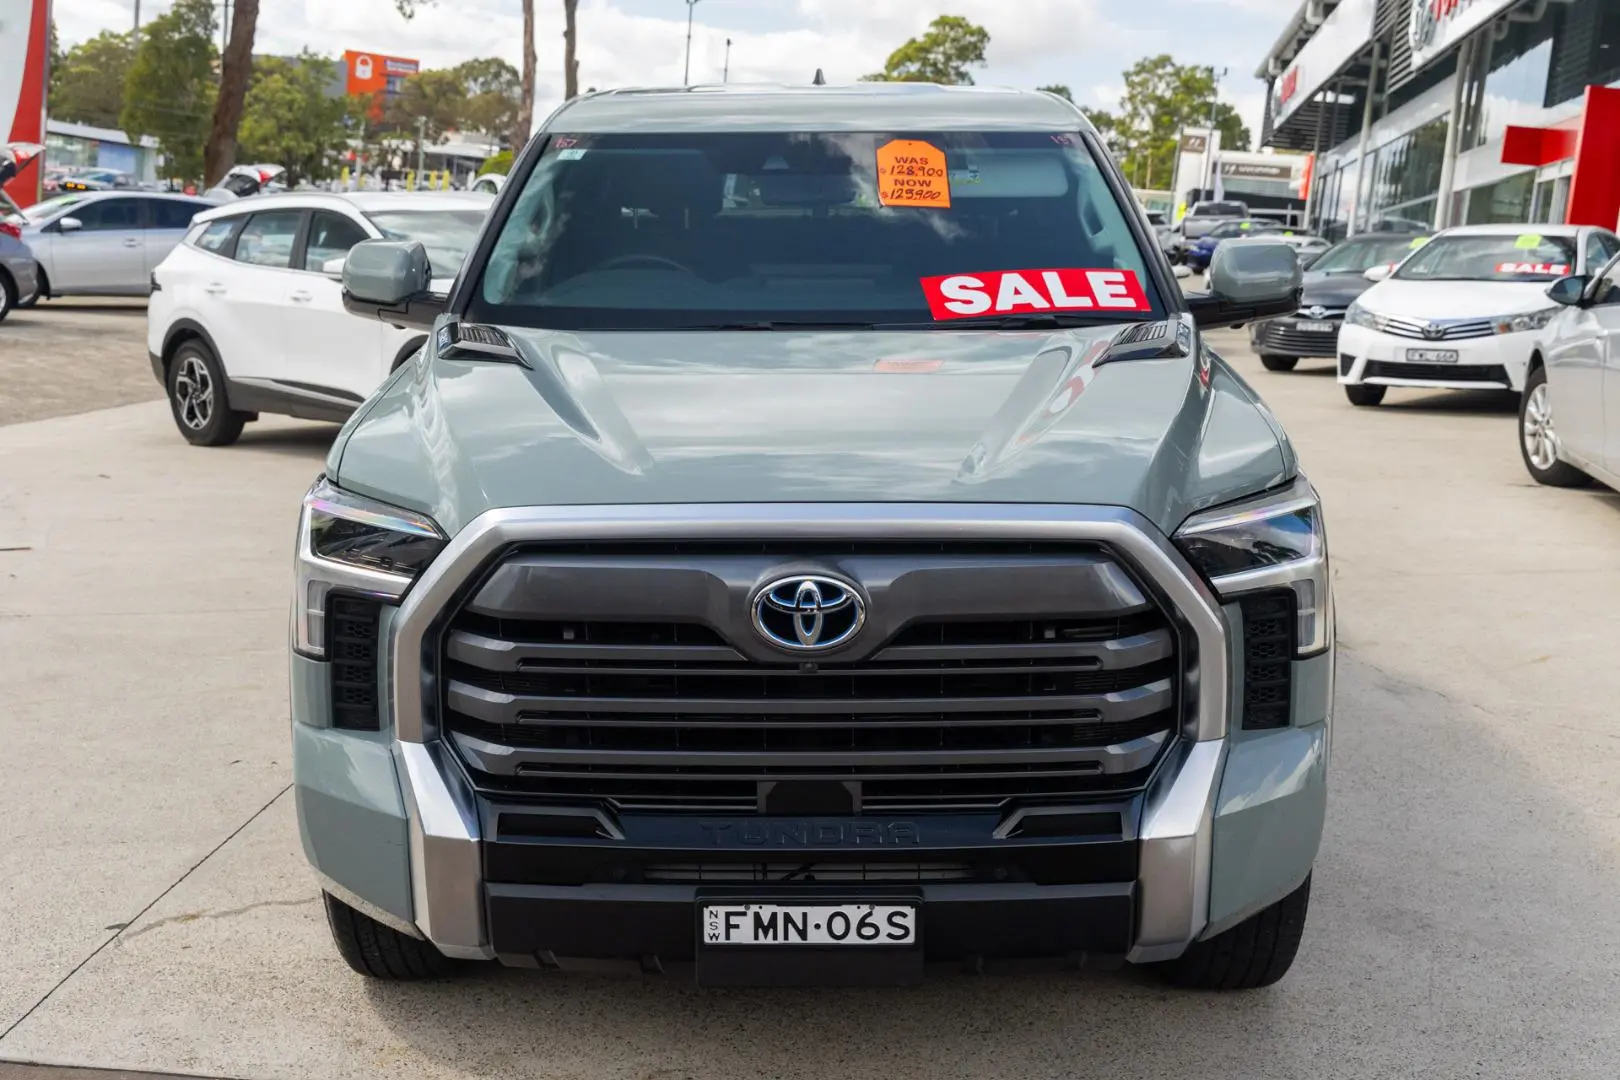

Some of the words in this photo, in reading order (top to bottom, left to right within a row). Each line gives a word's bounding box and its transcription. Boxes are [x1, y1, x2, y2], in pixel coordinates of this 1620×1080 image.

[894, 156, 929, 166] WAS
[894, 179, 932, 188] NOW
[1499, 263, 1566, 275] SALE
[939, 271, 1137, 315] SALE
[701, 822, 920, 844] TUNDRA
